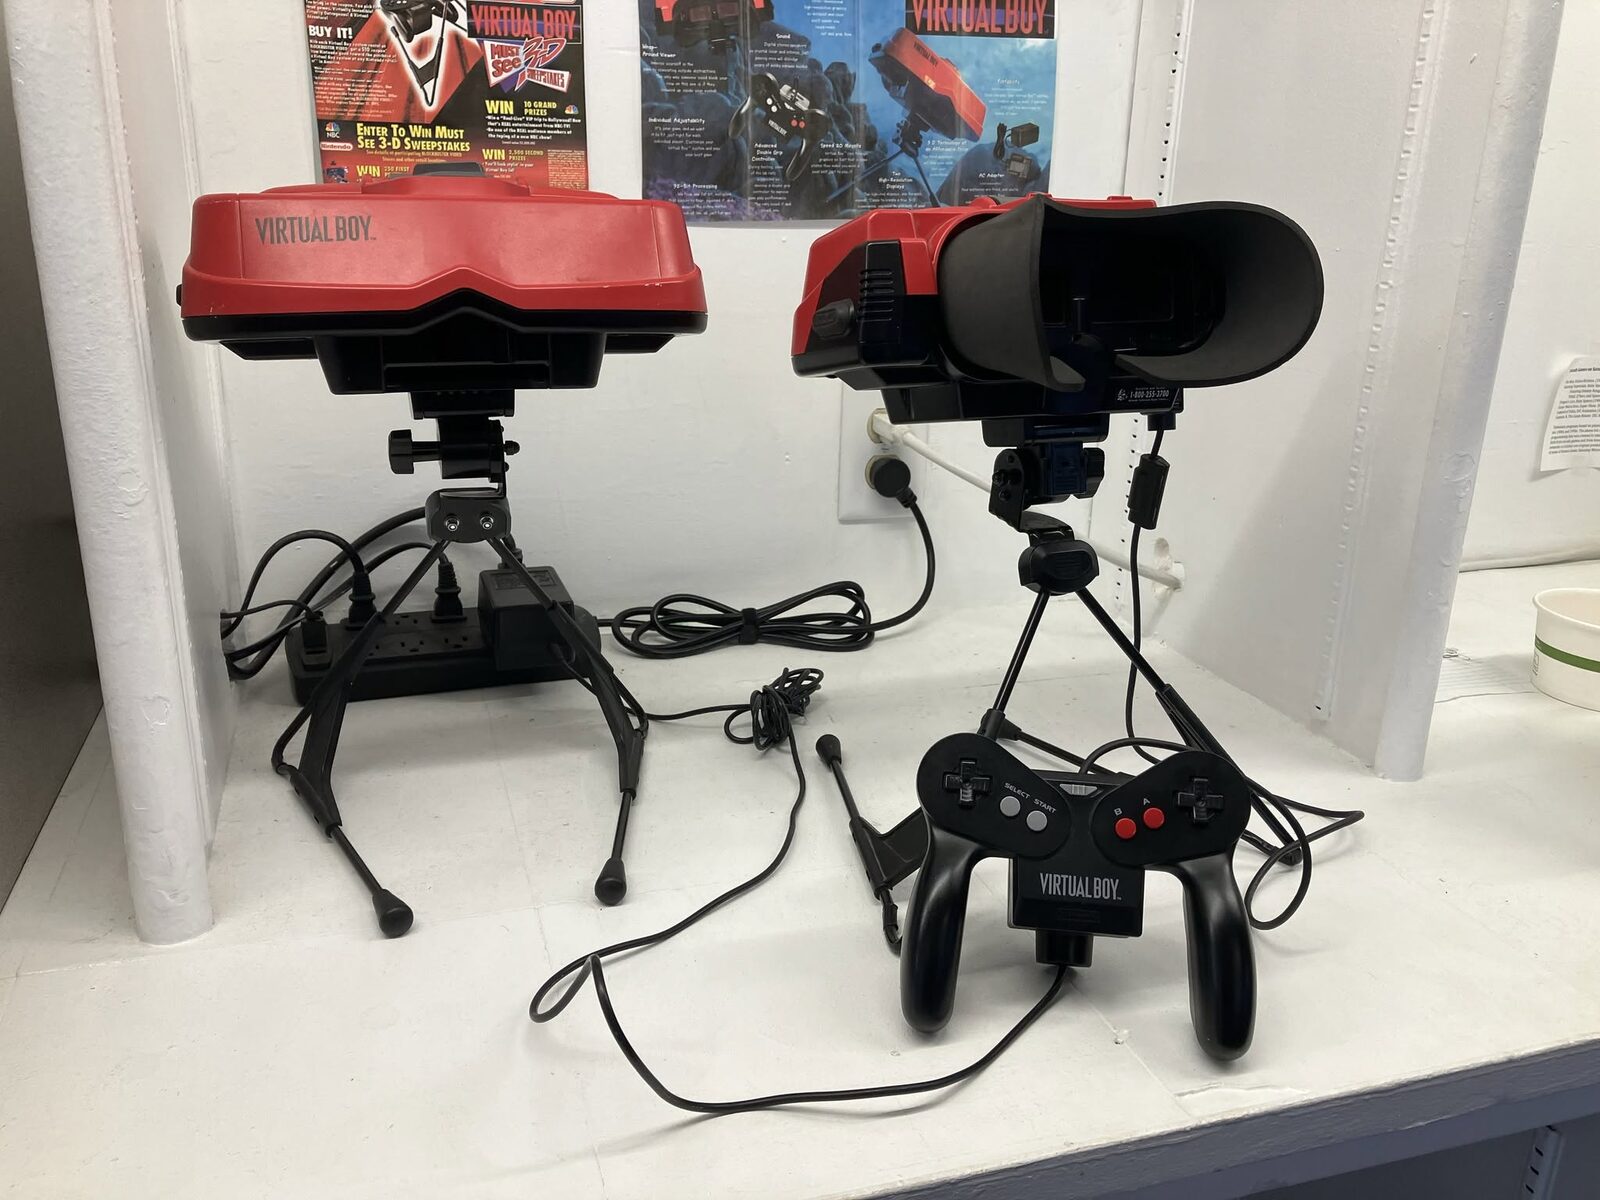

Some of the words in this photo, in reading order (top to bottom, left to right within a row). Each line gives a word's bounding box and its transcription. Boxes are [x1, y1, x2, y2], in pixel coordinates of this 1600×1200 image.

[471, 5, 538, 37] VIRTUAL
[543, 9, 576, 39] BOY
[912, 0, 1001, 33] VIRTUAL
[1005, 0, 1048, 34] BOY
[309, 25, 331, 37] BUY
[337, 27, 352, 39] IT!
[490, 44, 520, 59] MUST
[485, 100, 514, 114] WIN
[409, 125, 432, 139] WIN
[435, 126, 464, 139] MUST
[358, 137, 375, 149] SEE
[379, 137, 401, 149] 3-D
[404, 138, 470, 151] SWEEPSTAKES
[482, 149, 505, 160] WIN
[357, 165, 380, 177] WIN
[255, 216, 334, 245] VIRTUAL
[1130, 390, 1169, 398] 1-800-255-3700
[1004, 782, 1031, 799] SELECT
[1033, 798, 1057, 814] START
[1040, 872, 1092, 898] VIRTUAL
